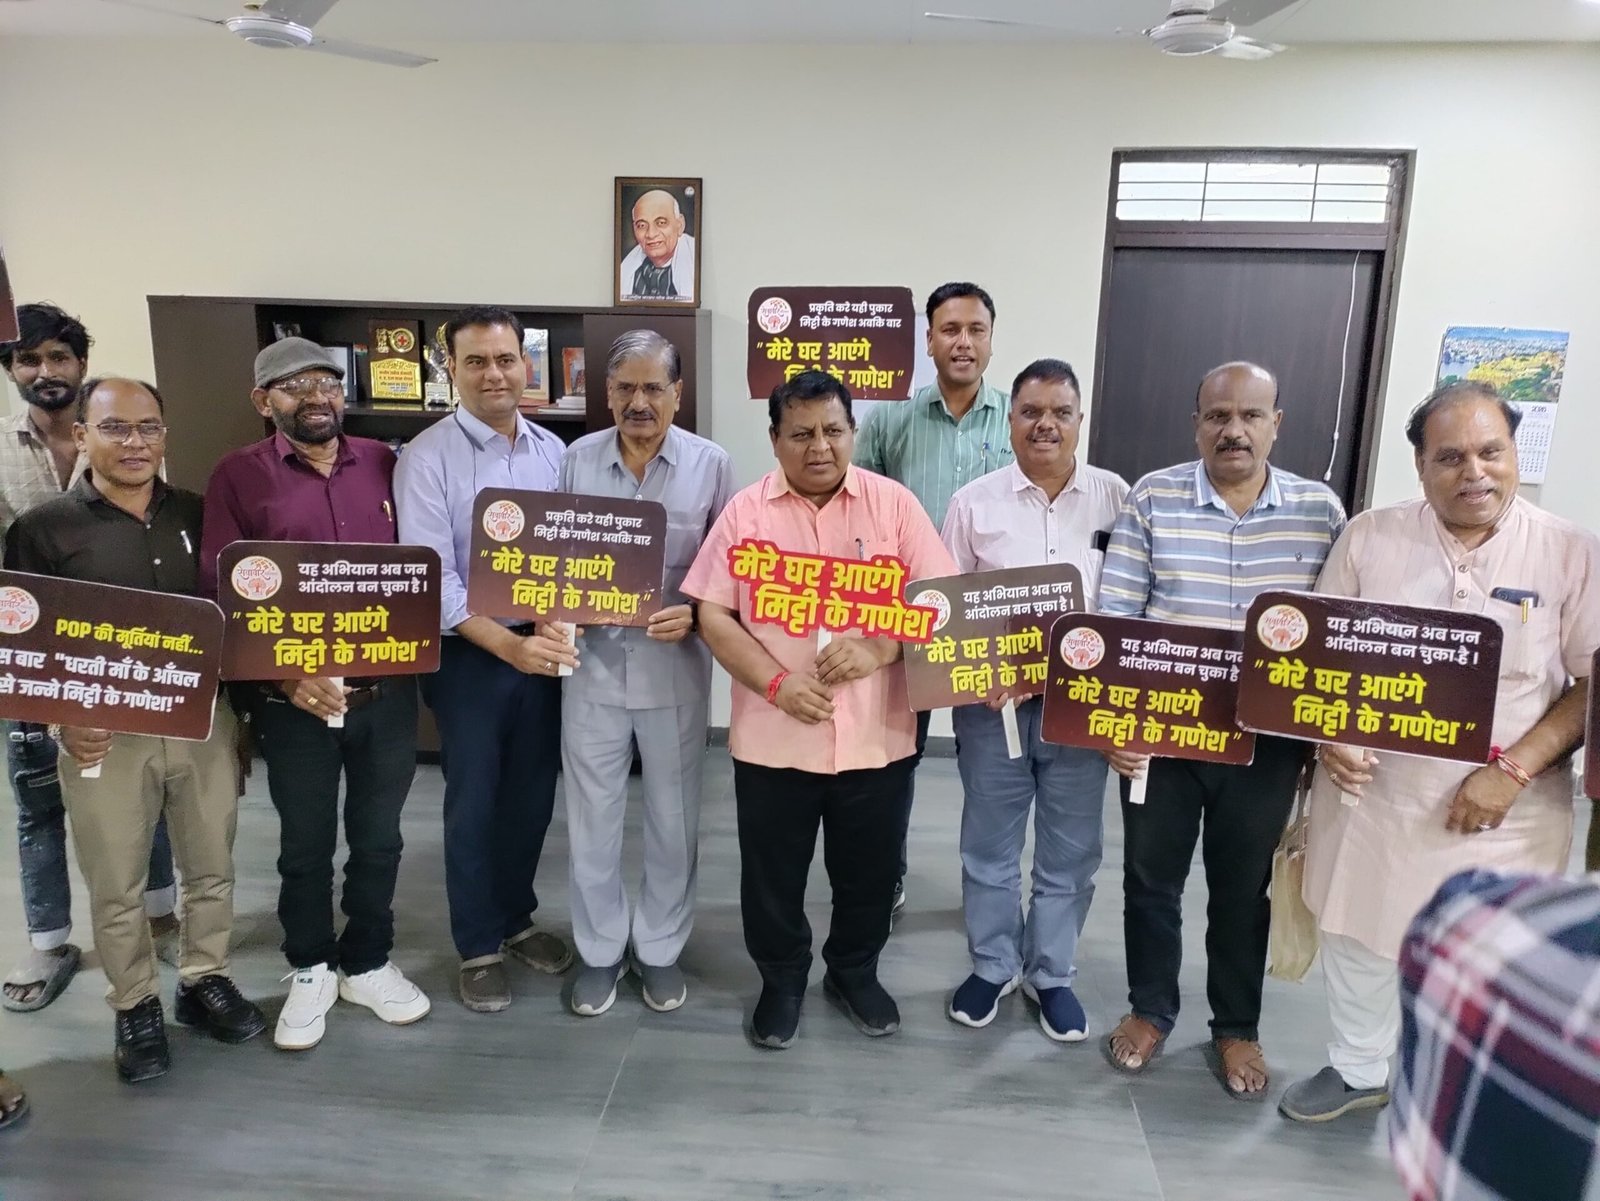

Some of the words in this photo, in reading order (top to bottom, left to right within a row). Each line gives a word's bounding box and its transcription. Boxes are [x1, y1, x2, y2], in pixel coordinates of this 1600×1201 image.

[799, 315, 820, 329] मिट्टी
[822, 316, 832, 327] के
[832, 316, 857, 328] गणेश
[808, 300, 835, 315] प्रकृति
[835, 301, 850, 312] करे
[851, 301, 868, 314] यही
[869, 304, 893, 316] पुकार
[766, 337, 794, 361] मेरे
[797, 342, 822, 361] घर
[827, 338, 871, 361] आएंगे
[849, 365, 894, 389] गणेश
[533, 524, 558, 541] मिट्टी
[559, 526, 571, 540] के
[571, 529, 601, 542] गणेश
[545, 510, 575, 525] प्रकृति
[576, 512, 594, 524] करे
[595, 513, 614, 526] यही
[615, 516, 643, 530] पुकार
[297, 563, 319, 577] यह
[321, 560, 378, 576] अभियान
[381, 564, 402, 576] अब
[403, 564, 428, 576] जन
[491, 546, 525, 575] मेरे
[529, 554, 559, 577] घर
[564, 554, 615, 582] आएंगे
[732, 542, 780, 582] मेरे
[783, 555, 826, 588] घर
[830, 558, 905, 598] आएंगे
[299, 578, 355, 593] आंदोलन
[356, 581, 379, 593] बन
[381, 581, 410, 597] चुका
[411, 577, 420, 593] है
[512, 579, 558, 615] मिट्टी
[562, 583, 583, 610] के
[587, 586, 640, 614] गणेश
[963, 591, 980, 604] यह
[982, 585, 1029, 601] अभियान
[1051, 582, 1072, 594] जन
[245, 606, 286, 634] मेरे
[290, 612, 325, 634] घर
[333, 605, 390, 633] आएंगे
[755, 583, 821, 634] मिट्टी
[824, 591, 854, 628] के
[856, 599, 933, 639] गणेश
[965, 604, 1011, 620] आंदोलन
[1032, 600, 1058, 617] चुका
[1059, 596, 1068, 612] है
[56, 619, 92, 638] POP
[94, 624, 114, 642] की
[116, 627, 161, 649] मूर्तियां
[925, 636, 957, 664] मेरे
[961, 637, 989, 660] घर
[996, 626, 1043, 656] आएंगे
[1326, 616, 1350, 633] यह
[1352, 617, 1419, 639] अभियान
[1421, 626, 1448, 642] अब
[1450, 629, 1481, 645] जन
[273, 637, 327, 674] मिट्टी
[333, 637, 356, 665] के
[361, 636, 419, 663] गणेश
[1121, 638, 1141, 653] यह
[1143, 639, 1199, 658] अभियान
[1200, 647, 1223, 661] अब
[1325, 634, 1388, 655] आंदोलन
[1390, 643, 1417, 658] बन
[1420, 644, 1455, 664] चुका
[1457, 645, 1470, 665] है
[14, 650, 47, 669] बार
[108, 656, 131, 680] माँ
[133, 660, 150, 681] के
[153, 662, 201, 688] आँचल
[950, 663, 993, 698] मिट्टी
[998, 661, 1018, 688] के
[1119, 654, 1173, 673] आंदोलन
[1174, 662, 1197, 676] बन
[1198, 665, 1228, 682] चुका
[1230, 664, 1240, 682] है
[1267, 656, 1309, 690] मेरे
[1313, 667, 1351, 696] घर
[1358, 672, 1427, 705] आएंगे
[18, 677, 61, 699] जन्मे
[62, 680, 102, 709] मिट्टी
[104, 688, 122, 706] के
[1068, 674, 1103, 705] मेरे
[1108, 684, 1140, 710] घर
[1145, 688, 1203, 717] आएंगे
[1088, 709, 1138, 748] मिट्टी
[1143, 715, 1165, 744] के
[1170, 722, 1229, 753] गणेश
[1293, 694, 1351, 737] मिट्टी
[1356, 702, 1383, 735] के
[1389, 710, 1461, 745] गणेश
